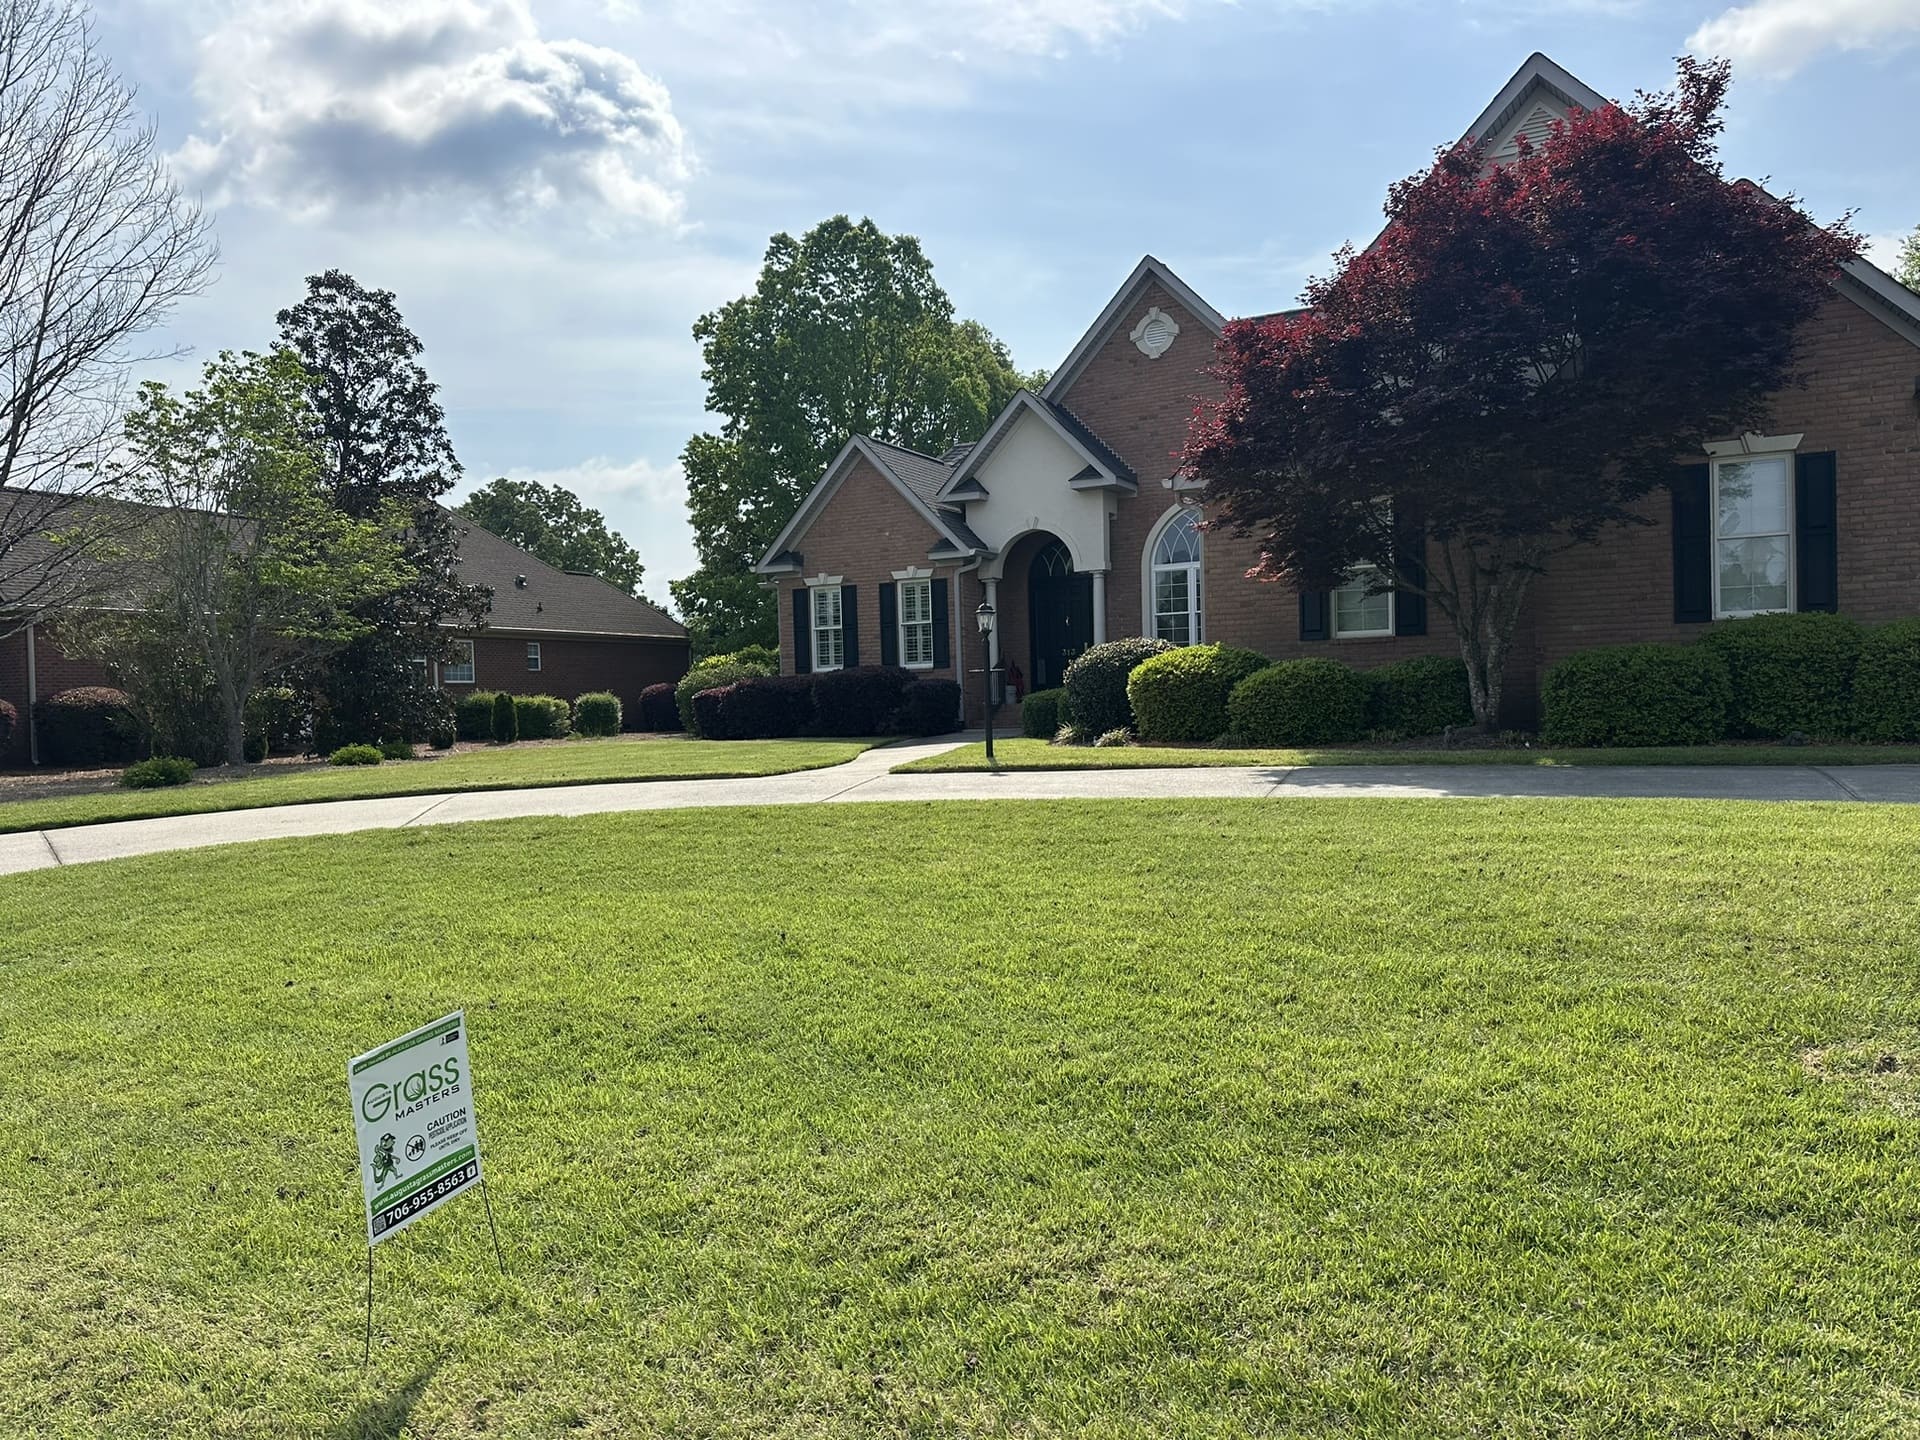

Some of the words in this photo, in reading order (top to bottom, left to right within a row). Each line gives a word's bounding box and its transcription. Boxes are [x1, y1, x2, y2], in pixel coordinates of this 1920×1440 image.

[362, 1056, 460, 1123] Grass
[395, 1084, 460, 1121] MASTERS
[426, 1106, 467, 1132] CAUTION
[374, 1149, 474, 1210] www.augustagrassmasters.com
[386, 1170, 465, 1225] 706-955-8563
